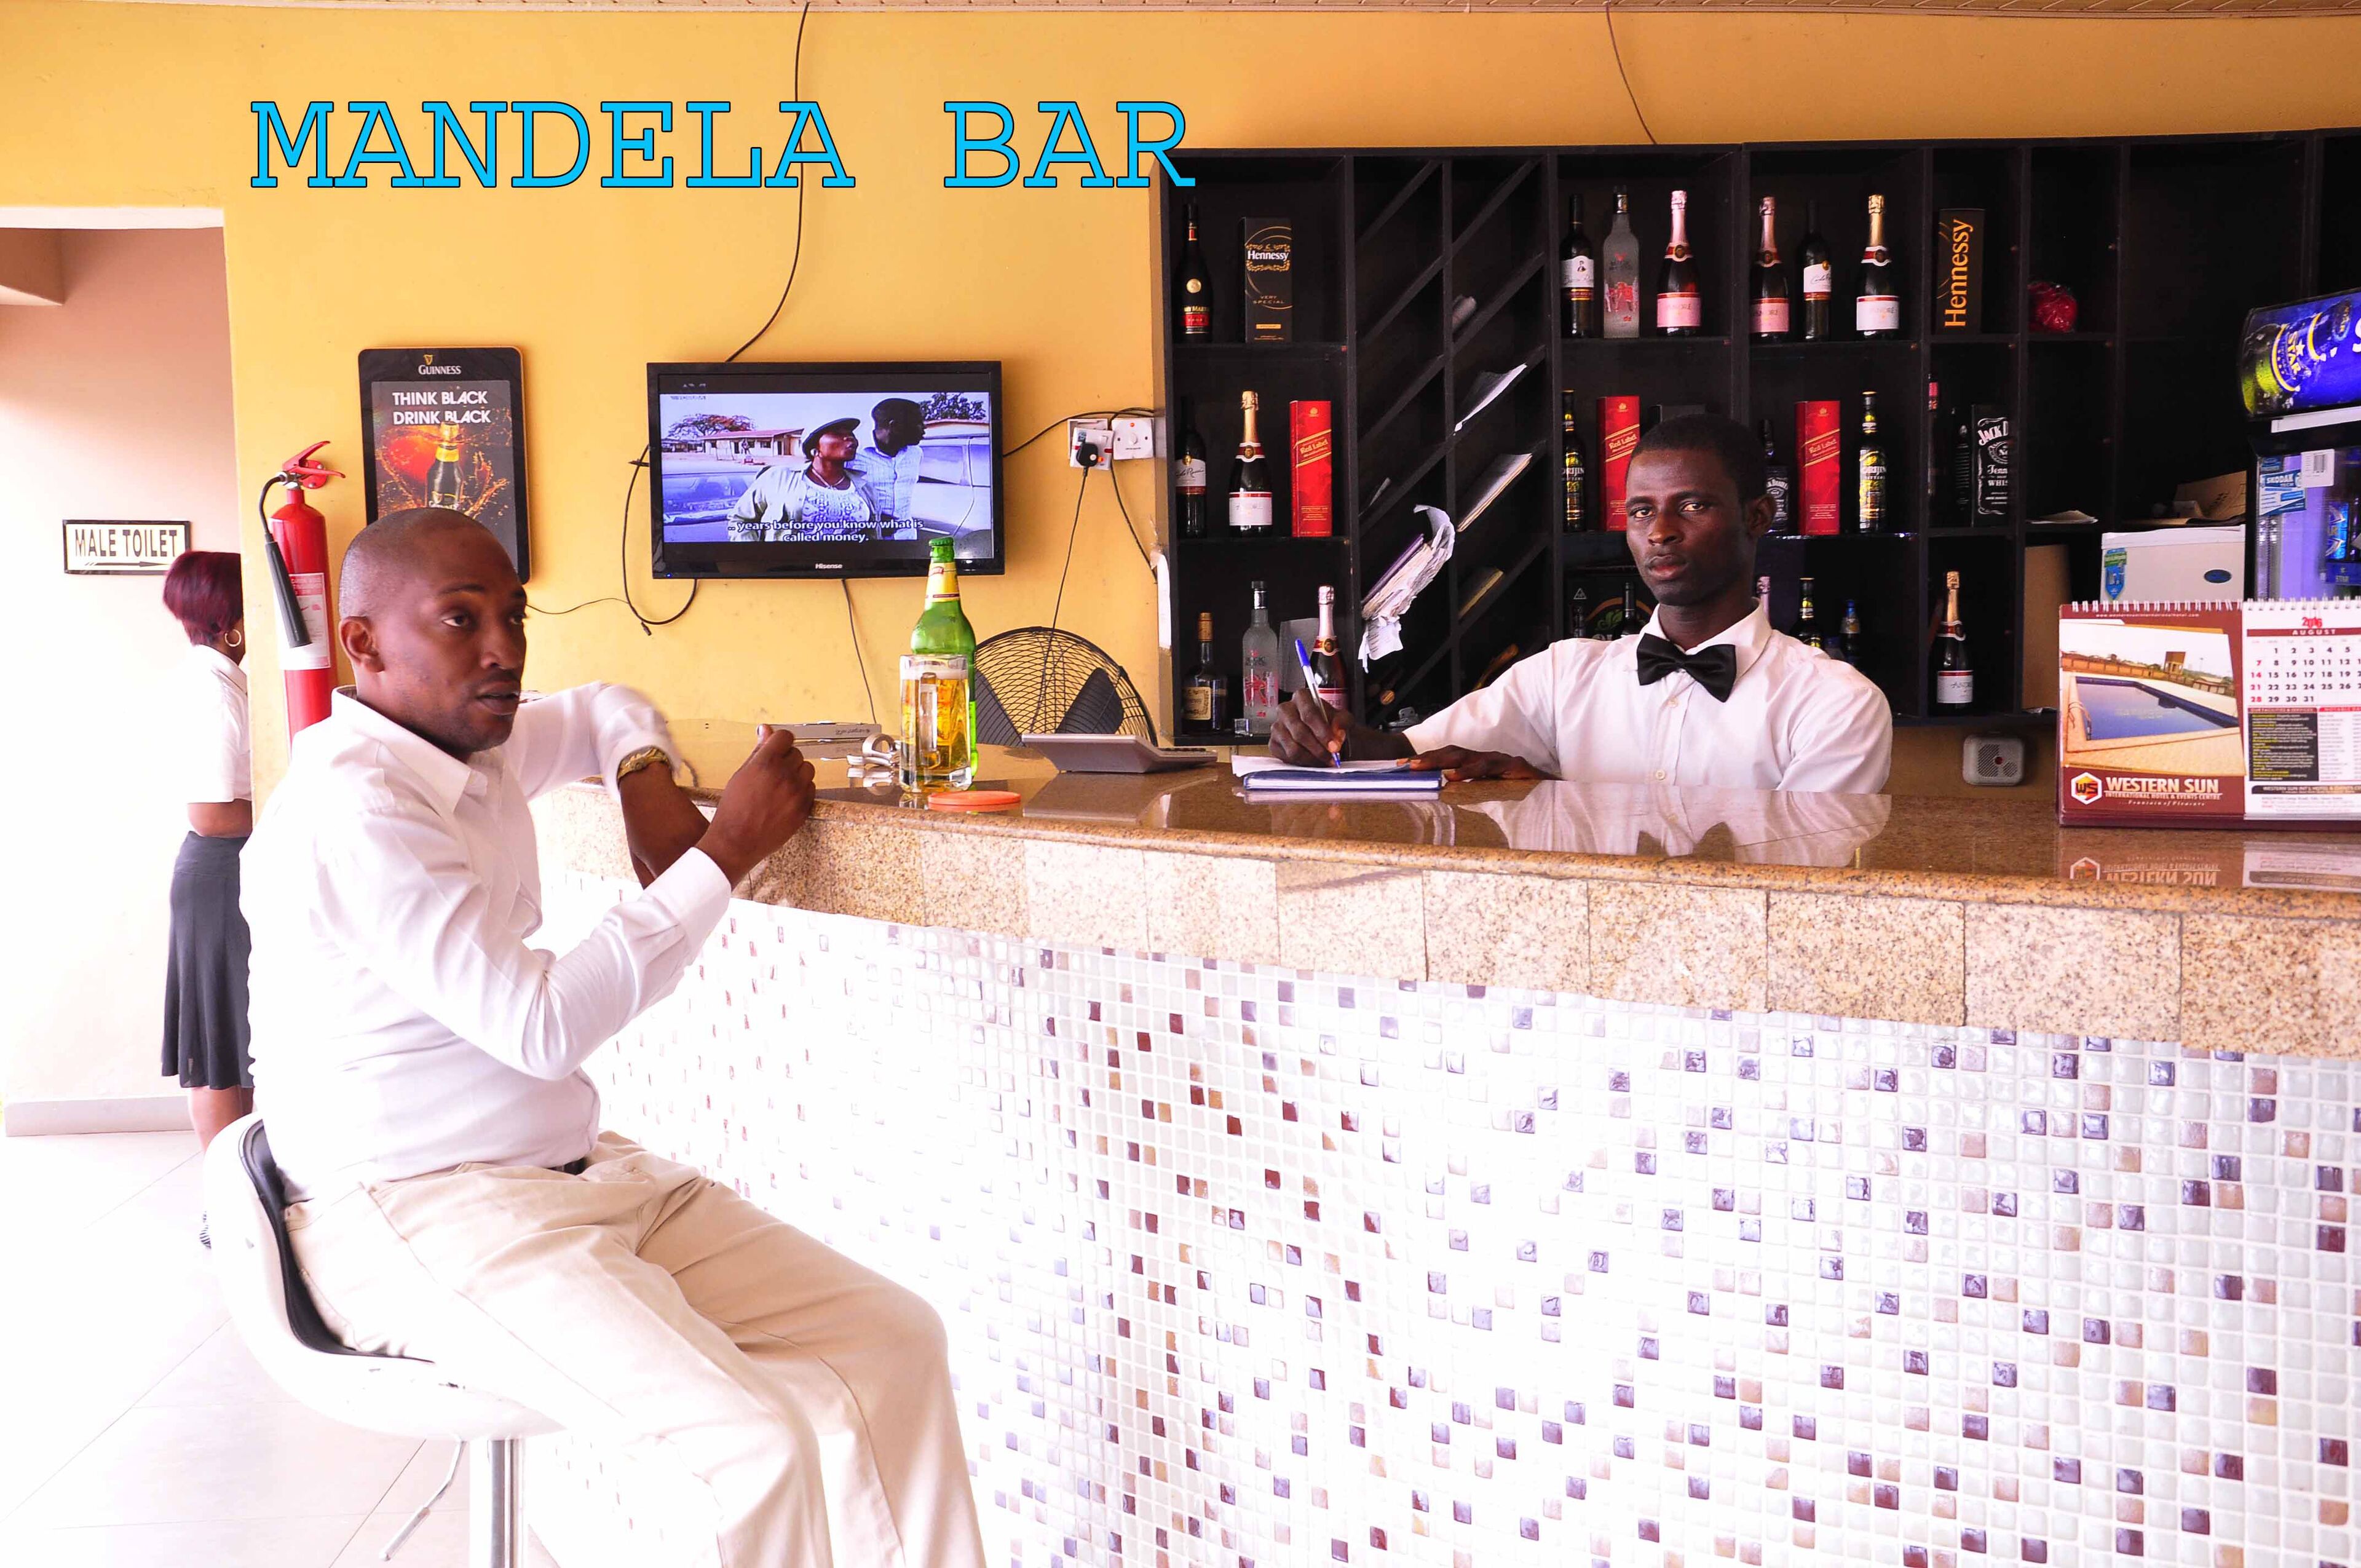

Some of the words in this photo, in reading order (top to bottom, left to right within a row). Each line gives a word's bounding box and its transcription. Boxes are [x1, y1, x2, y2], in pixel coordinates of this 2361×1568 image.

[1247, 250, 1289, 261] Hennessy
[1944, 219, 1974, 327] Hennessy
[418, 365, 462, 374] GUINNESS
[392, 392, 438, 406] THINK
[441, 391, 488, 405] BLACK
[393, 411, 440, 425] DRINK
[445, 410, 491, 424] BLACK
[1608, 440, 1621, 449] Red
[1621, 434, 1638, 445] Label
[1977, 426, 2003, 446] JACK
[1300, 444, 1313, 454] Red
[1313, 439, 1328, 450] Label
[1809, 443, 1821, 454] Red
[1821, 438, 1837, 450] Label
[738, 521, 771, 531] years
[773, 520, 813, 529] before
[817, 521, 840, 531] you
[842, 520, 877, 529] know
[880, 520, 911, 529] what
[912, 520, 923, 528] is
[75, 529, 117, 557] MALE
[122, 529, 178, 557] TOILET
[783, 533, 820, 542] called
[823, 533, 869, 542] money.
[2105, 777, 2180, 792] WESTERN
[2184, 778, 2219, 793] SUN
